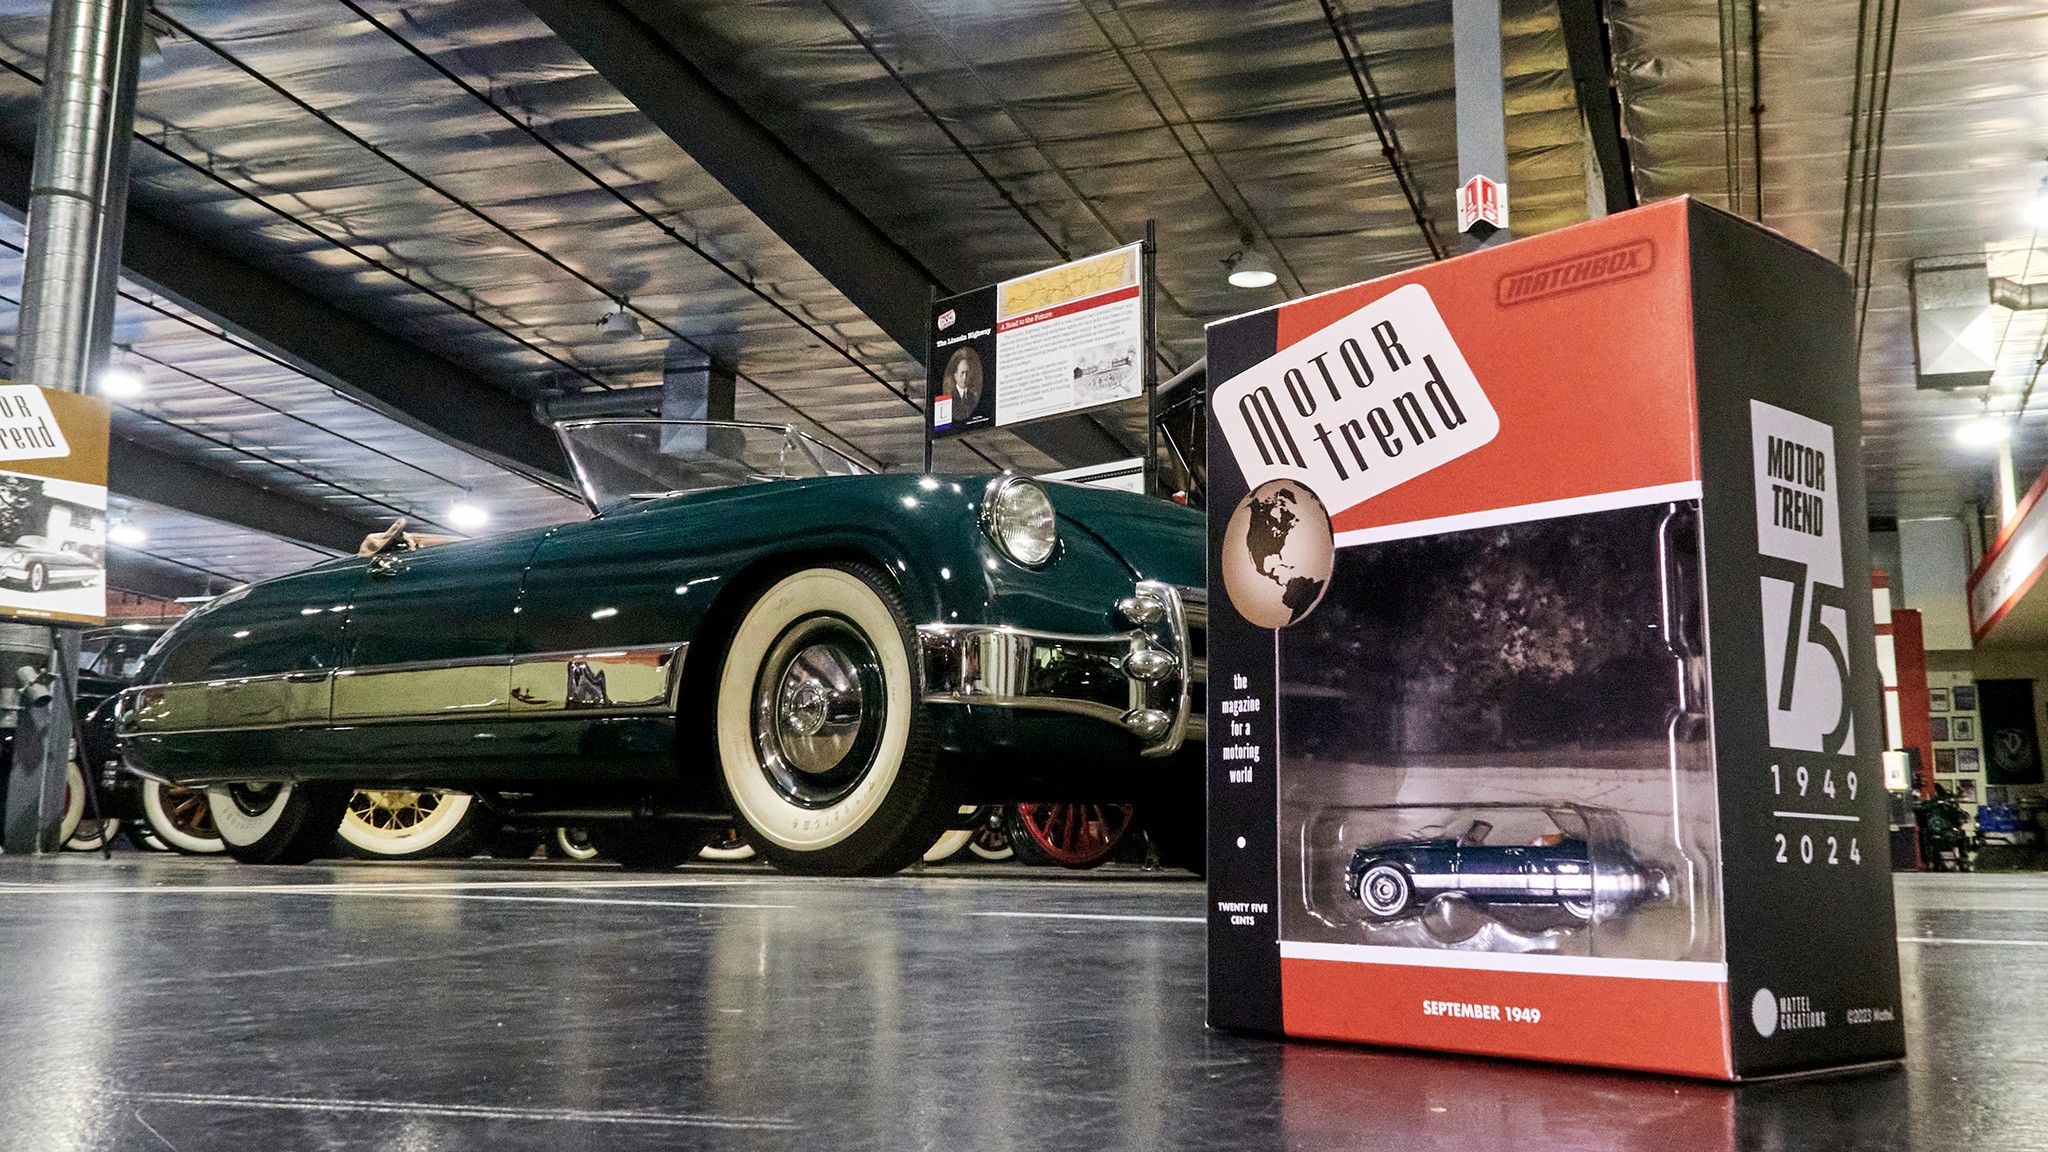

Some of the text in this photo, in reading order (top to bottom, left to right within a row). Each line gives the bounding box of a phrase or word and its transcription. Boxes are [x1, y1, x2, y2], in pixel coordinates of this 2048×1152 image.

[1507, 250, 1640, 299] MATCHBOX
[1238, 319, 1412, 470] MOTOR
[1313, 354, 1468, 482] trend
[1767, 435, 1825, 492] MOTOR
[1772, 484, 1824, 537] TREND
[1758, 552, 1853, 754] 75
[1233, 673, 1248, 690] the
[1221, 695, 1260, 717] magazine
[1231, 720, 1251, 736] for a
[1223, 742, 1260, 762] motoring
[1229, 766, 1253, 783] world
[1770, 764, 1858, 800] 1949
[1774, 833, 1861, 865] 2024
[1217, 901, 1268, 913] TWENTY FIVE
[1230, 915, 1255, 926] CENTS
[1423, 1000, 1541, 1023] SEPTEMBER 1949
[1779, 996, 1811, 1013] MATTEL
[1780, 1011, 1827, 1030] CREATIONS
